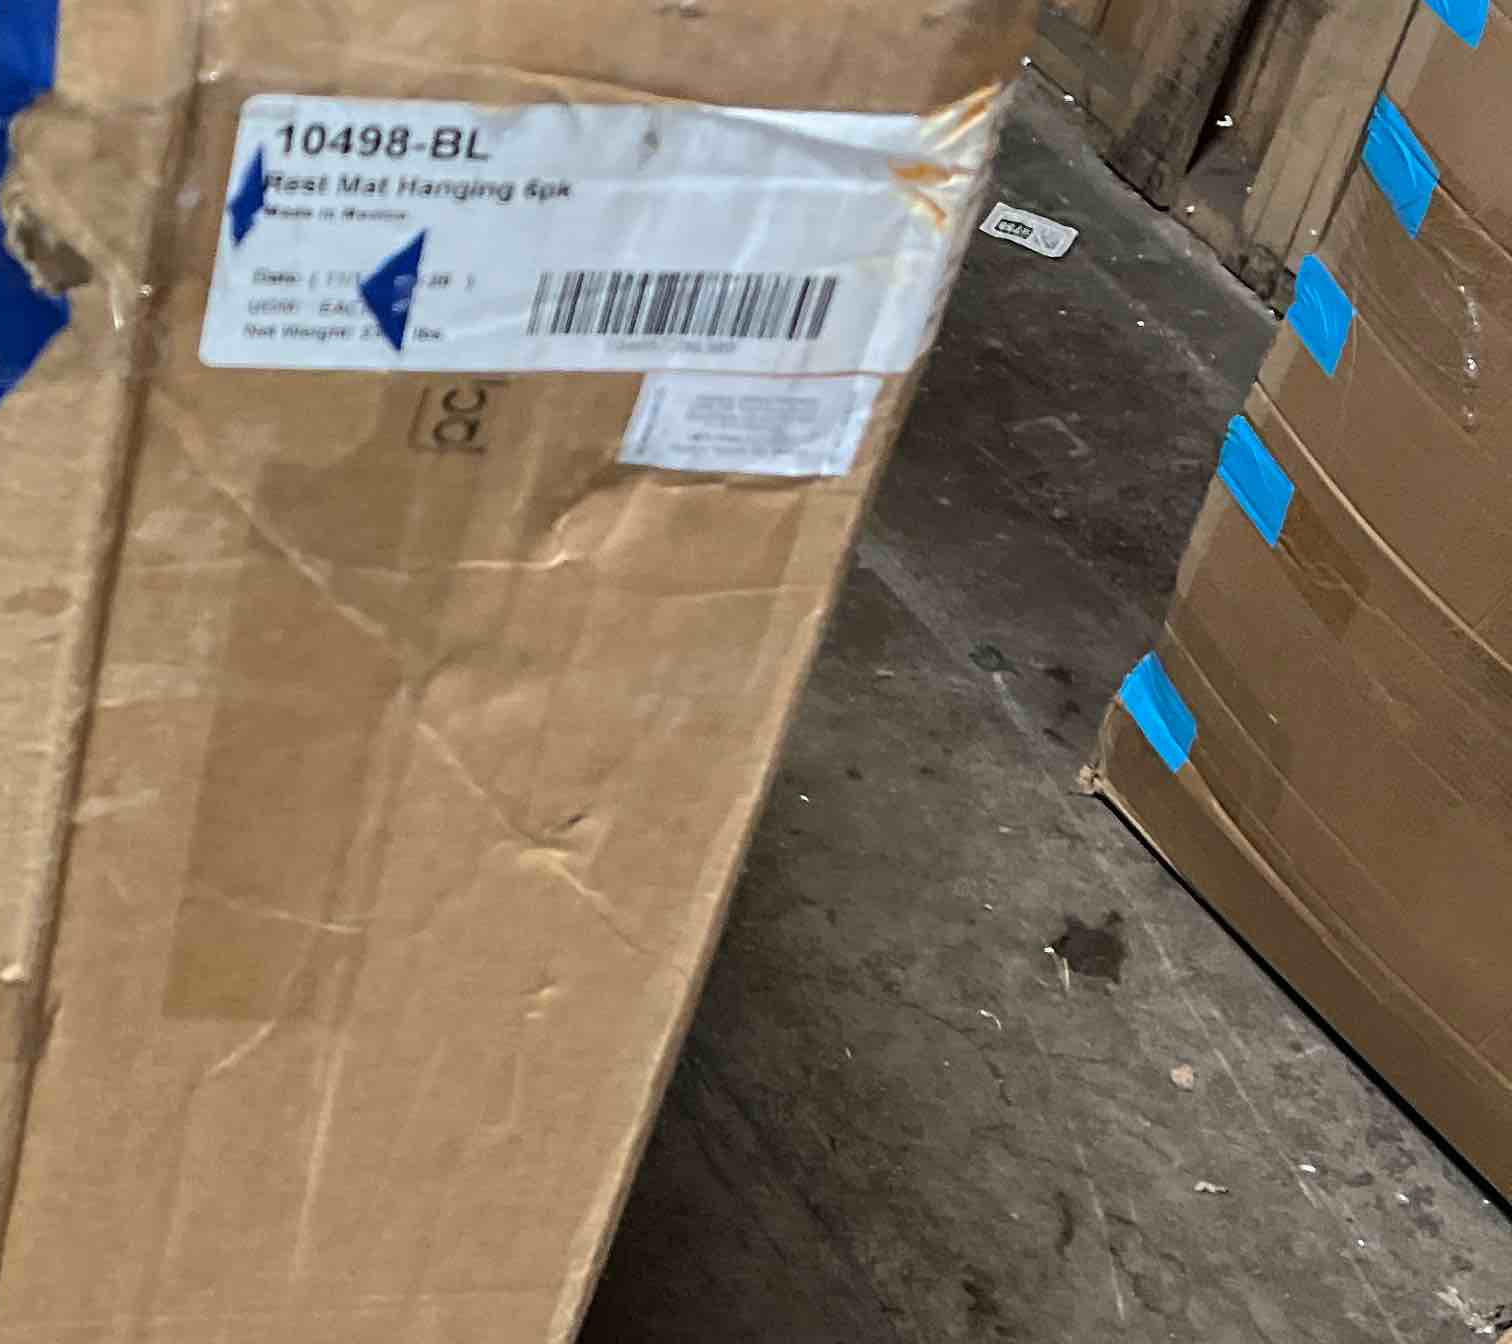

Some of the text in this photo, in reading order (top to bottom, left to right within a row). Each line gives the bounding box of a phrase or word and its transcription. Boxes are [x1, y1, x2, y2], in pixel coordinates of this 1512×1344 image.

[275, 121, 493, 162] 10498-BL
[338, 175, 388, 199] Mat
[397, 176, 516, 204] Hanging
